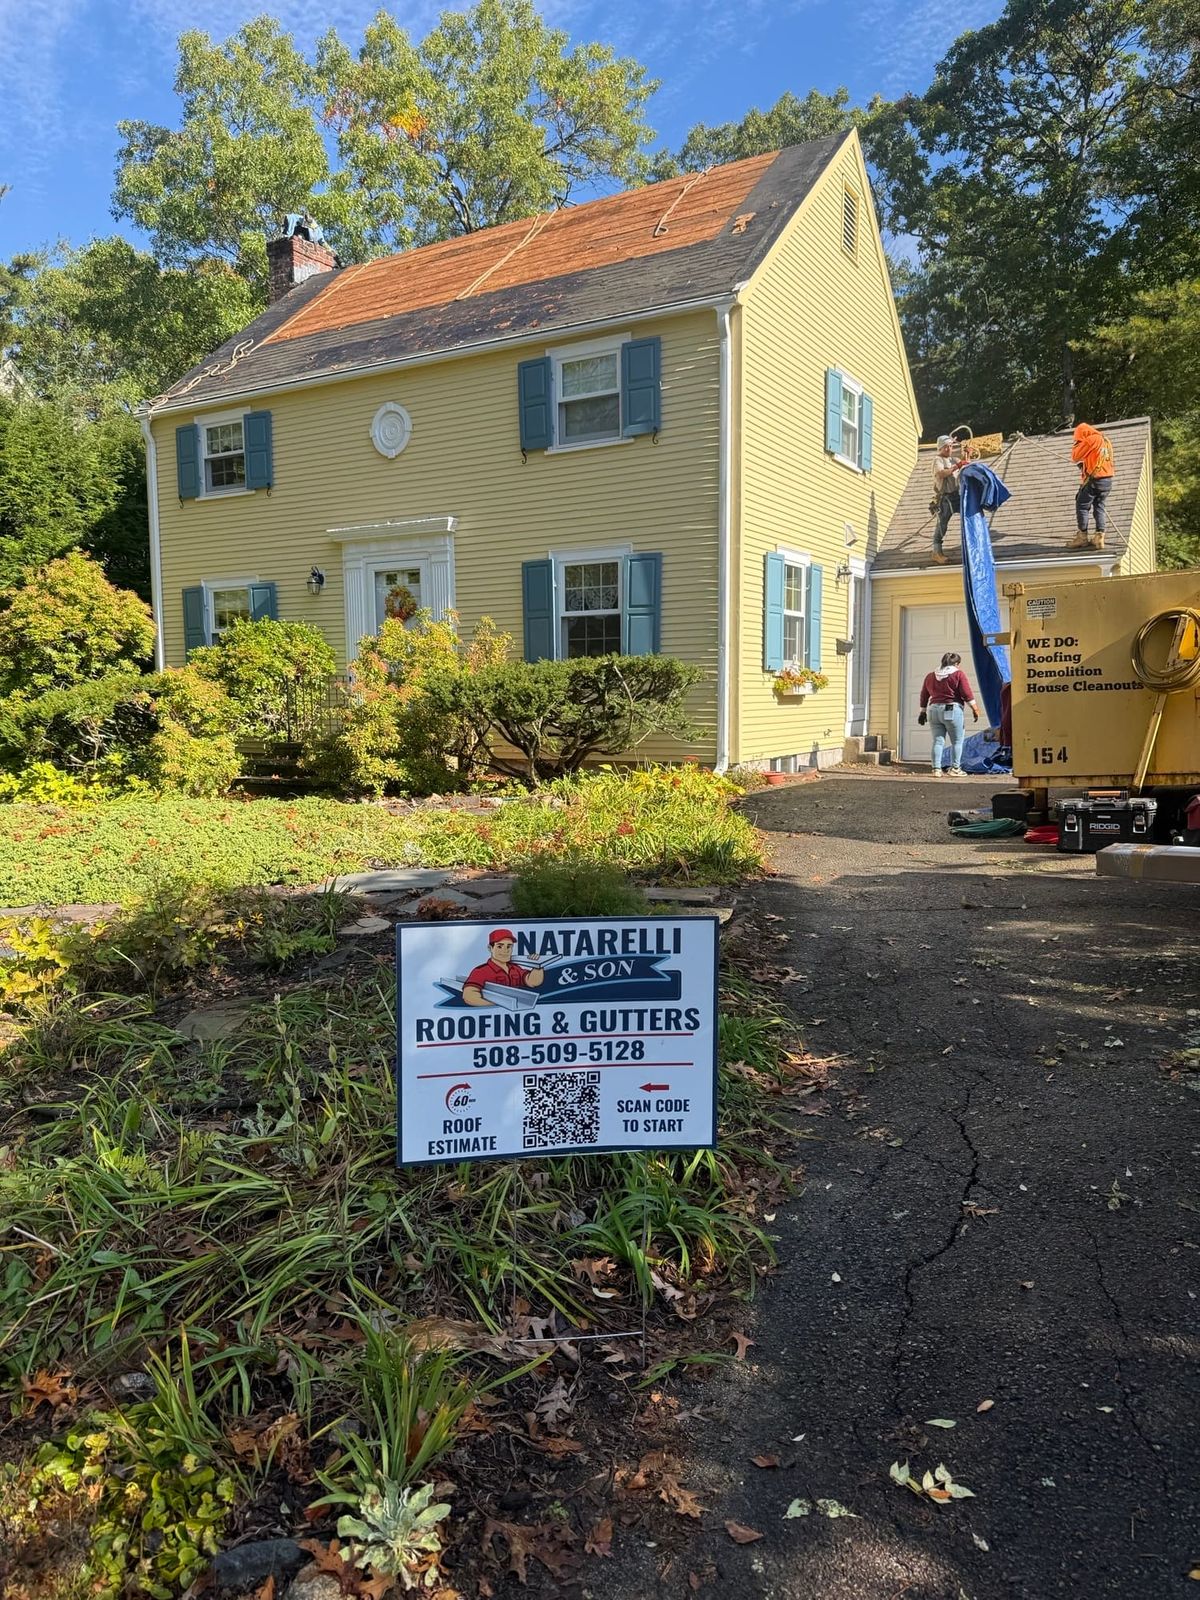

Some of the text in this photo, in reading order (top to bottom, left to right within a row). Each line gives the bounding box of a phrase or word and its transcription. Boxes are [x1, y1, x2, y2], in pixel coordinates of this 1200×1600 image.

[1027, 598, 1055, 606] CAUTION
[1027, 637, 1079, 648] WE DO:
[1027, 652, 1082, 663] Roofing
[1027, 666, 1103, 679] Demolition
[1027, 681, 1144, 693] House Cleanouts
[1033, 746, 1069, 764] 154
[518, 927, 682, 956] NATARELLI
[558, 960, 634, 986] & SON
[416, 1008, 700, 1042] ROOFING & GUTTERS
[473, 1040, 645, 1068] 508-509-5128
[454, 1095, 469, 1107] 60
[617, 1098, 690, 1113] SCAN CODE
[443, 1117, 482, 1134] ROOF
[623, 1118, 684, 1132] TO START
[428, 1136, 497, 1155] ESTIMATE
